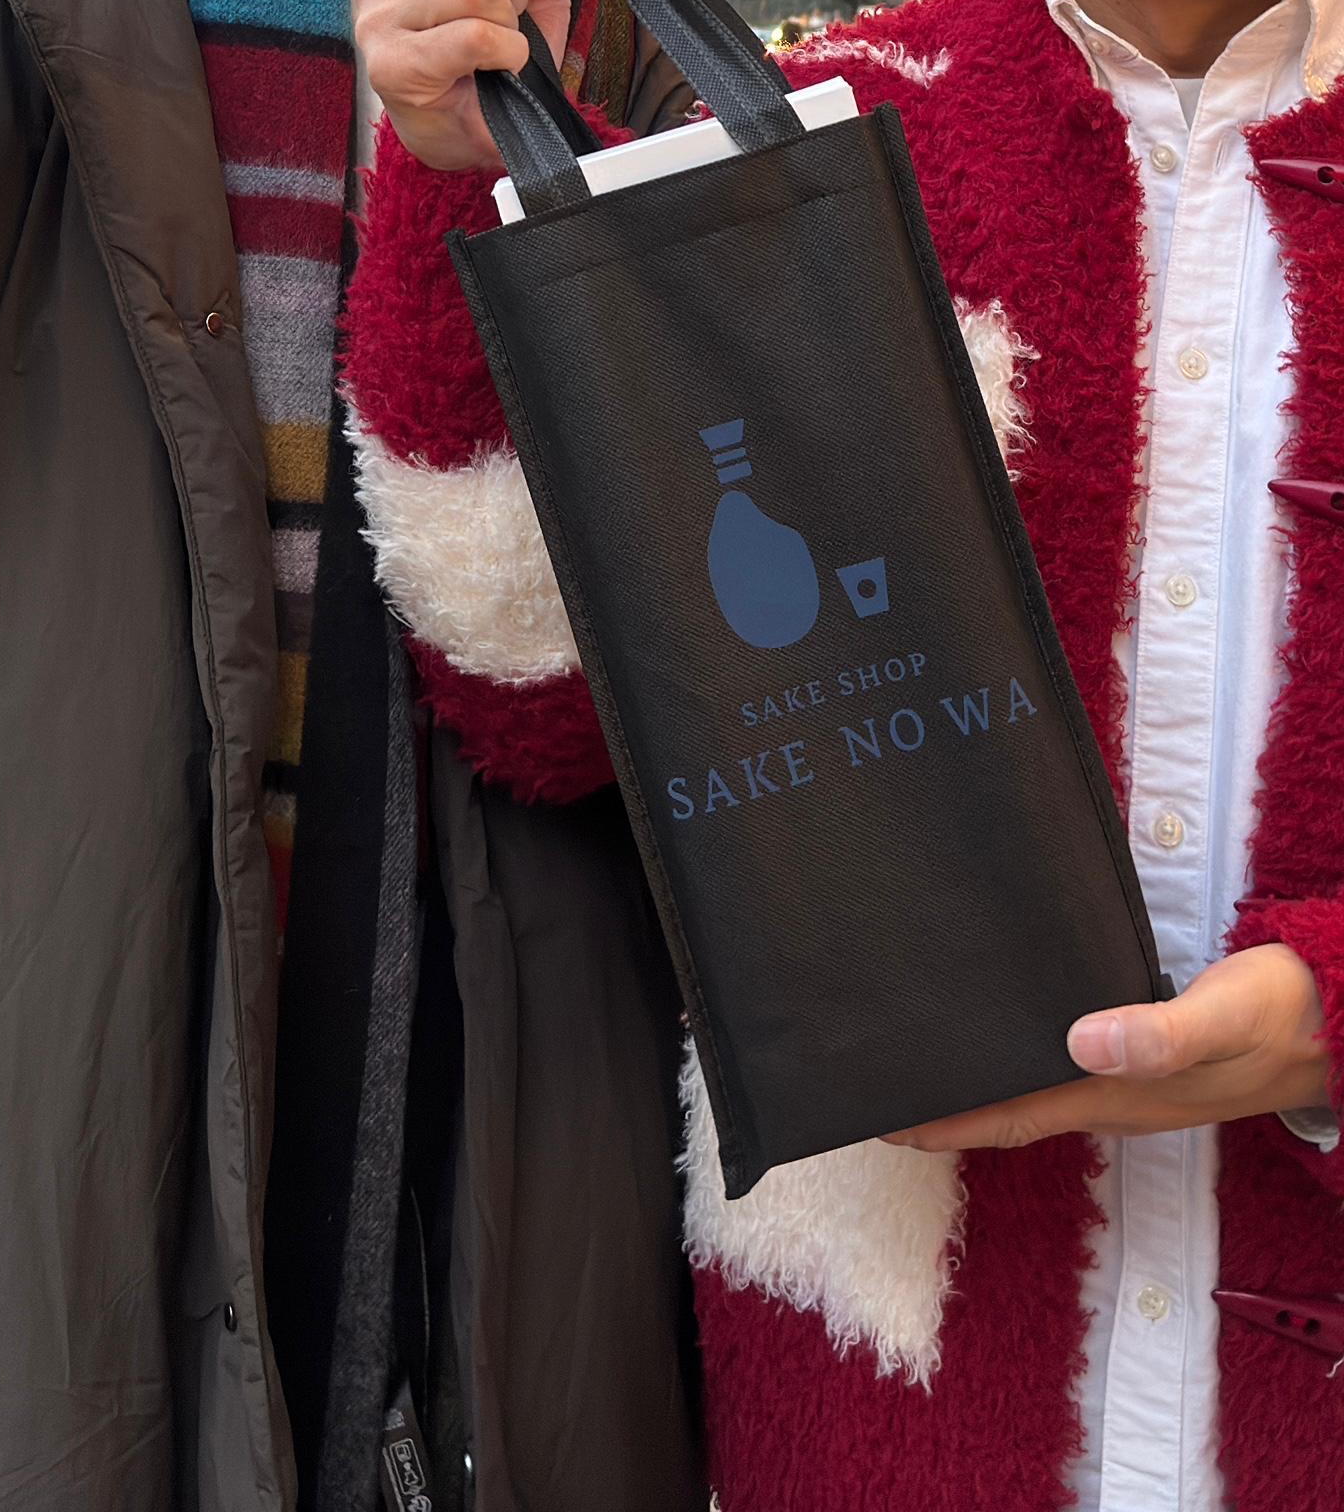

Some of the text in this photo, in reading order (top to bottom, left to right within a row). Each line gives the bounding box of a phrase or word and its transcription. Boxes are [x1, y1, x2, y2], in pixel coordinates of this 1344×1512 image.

[740, 652, 927, 727] SAKE SHOP
[666, 741, 816, 821] SAKE
